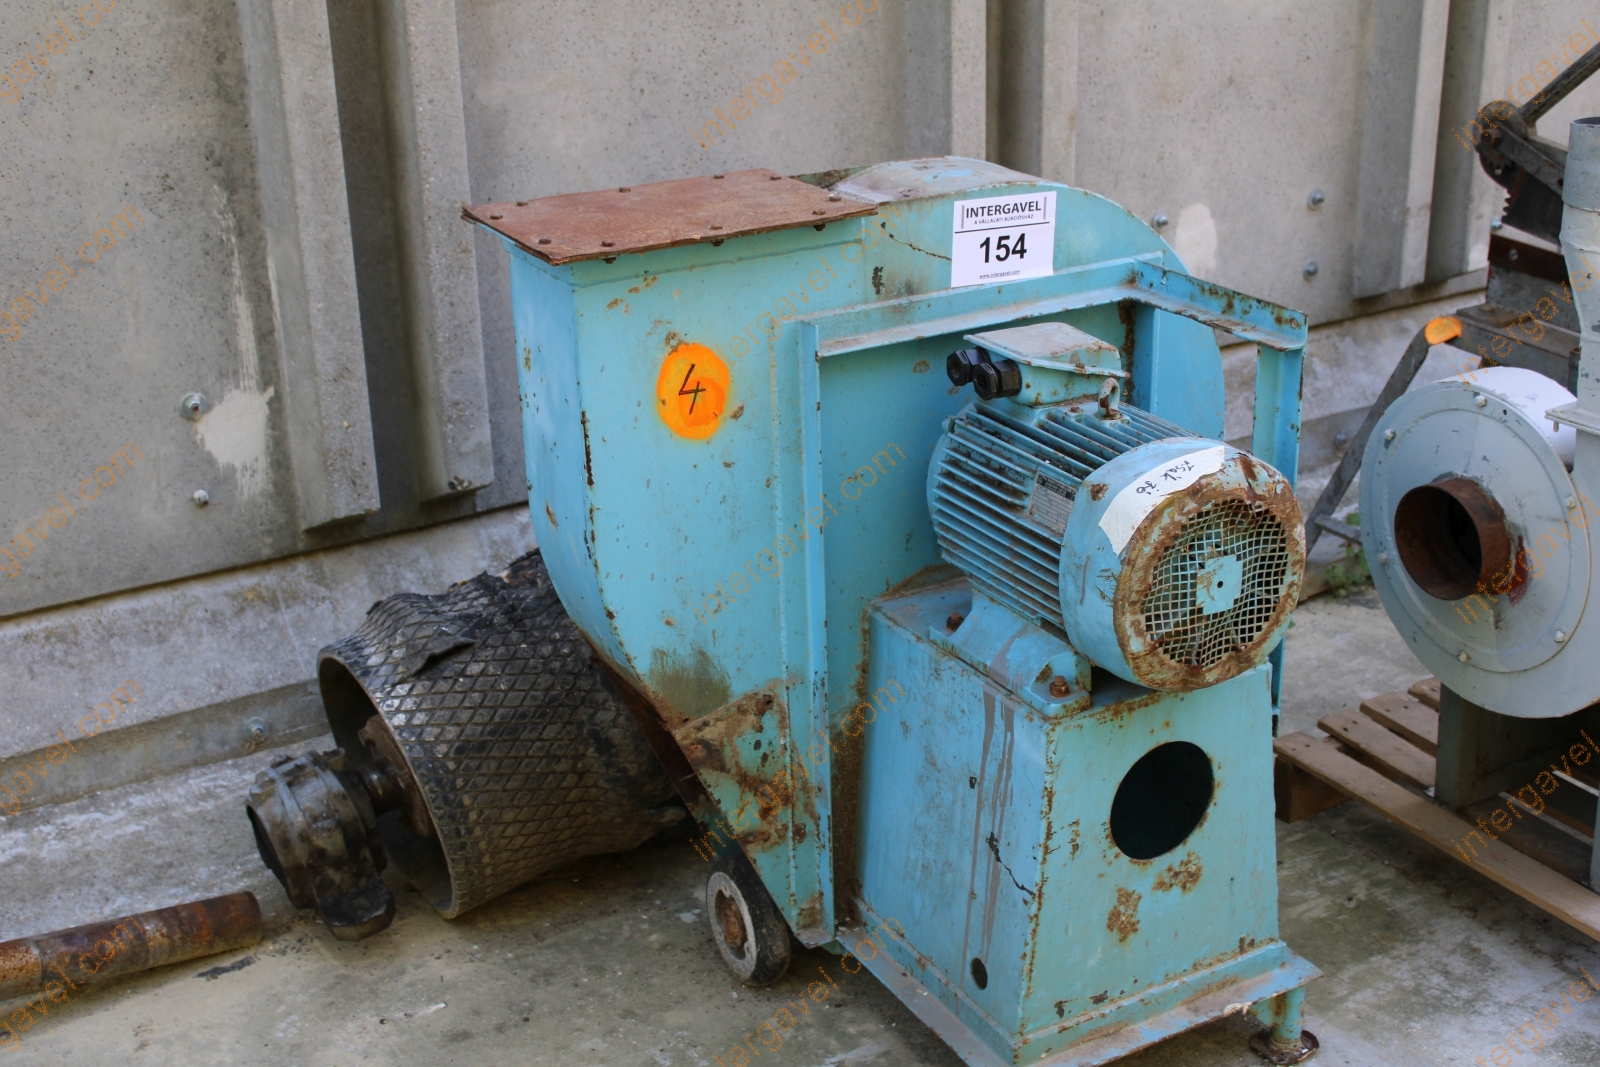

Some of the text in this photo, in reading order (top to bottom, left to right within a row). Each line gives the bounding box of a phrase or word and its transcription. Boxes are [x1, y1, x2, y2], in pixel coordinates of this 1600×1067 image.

[966, 201, 1041, 218] INTERGAVEL
[979, 233, 1027, 263] 154
[979, 270, 1020, 279] www.intergavel.com
[678, 363, 706, 416] 4
